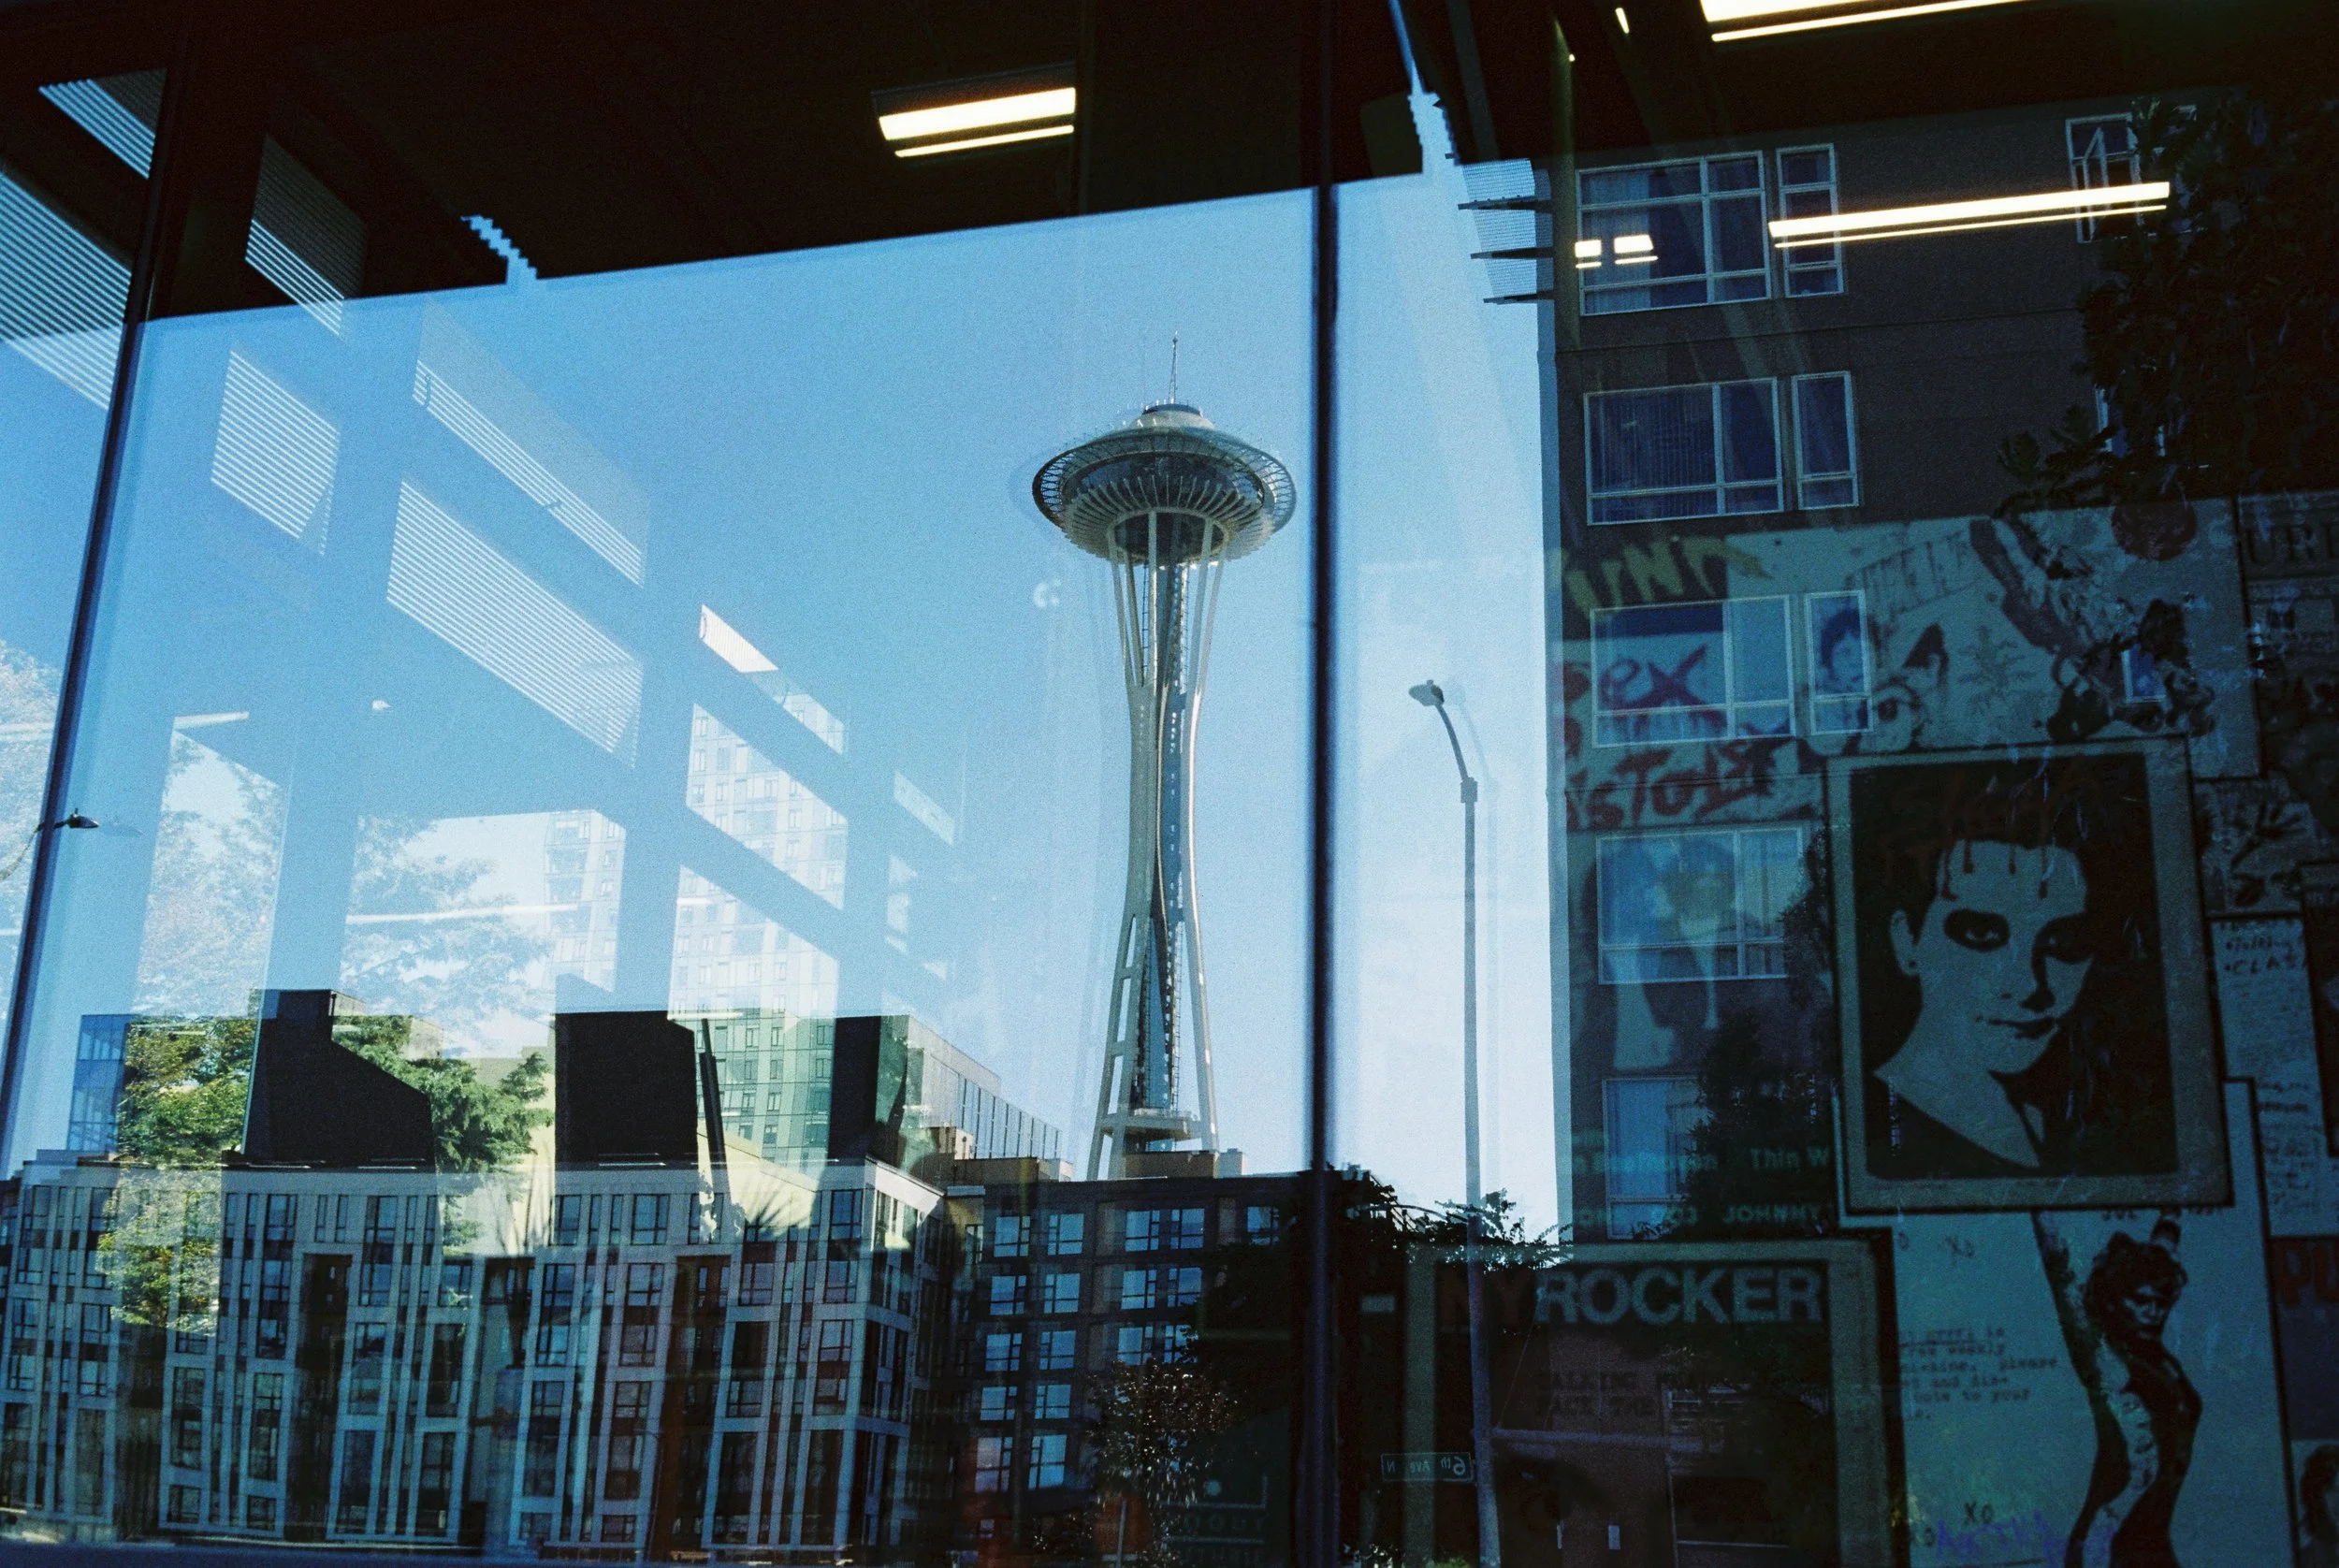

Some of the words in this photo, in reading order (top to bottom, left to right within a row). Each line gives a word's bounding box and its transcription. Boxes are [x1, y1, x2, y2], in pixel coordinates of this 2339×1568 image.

[1722, 1204, 1818, 1227] JOHNNY
[1534, 1265, 1823, 1324] ROCKER
[1998, 1357, 2057, 1372] please
